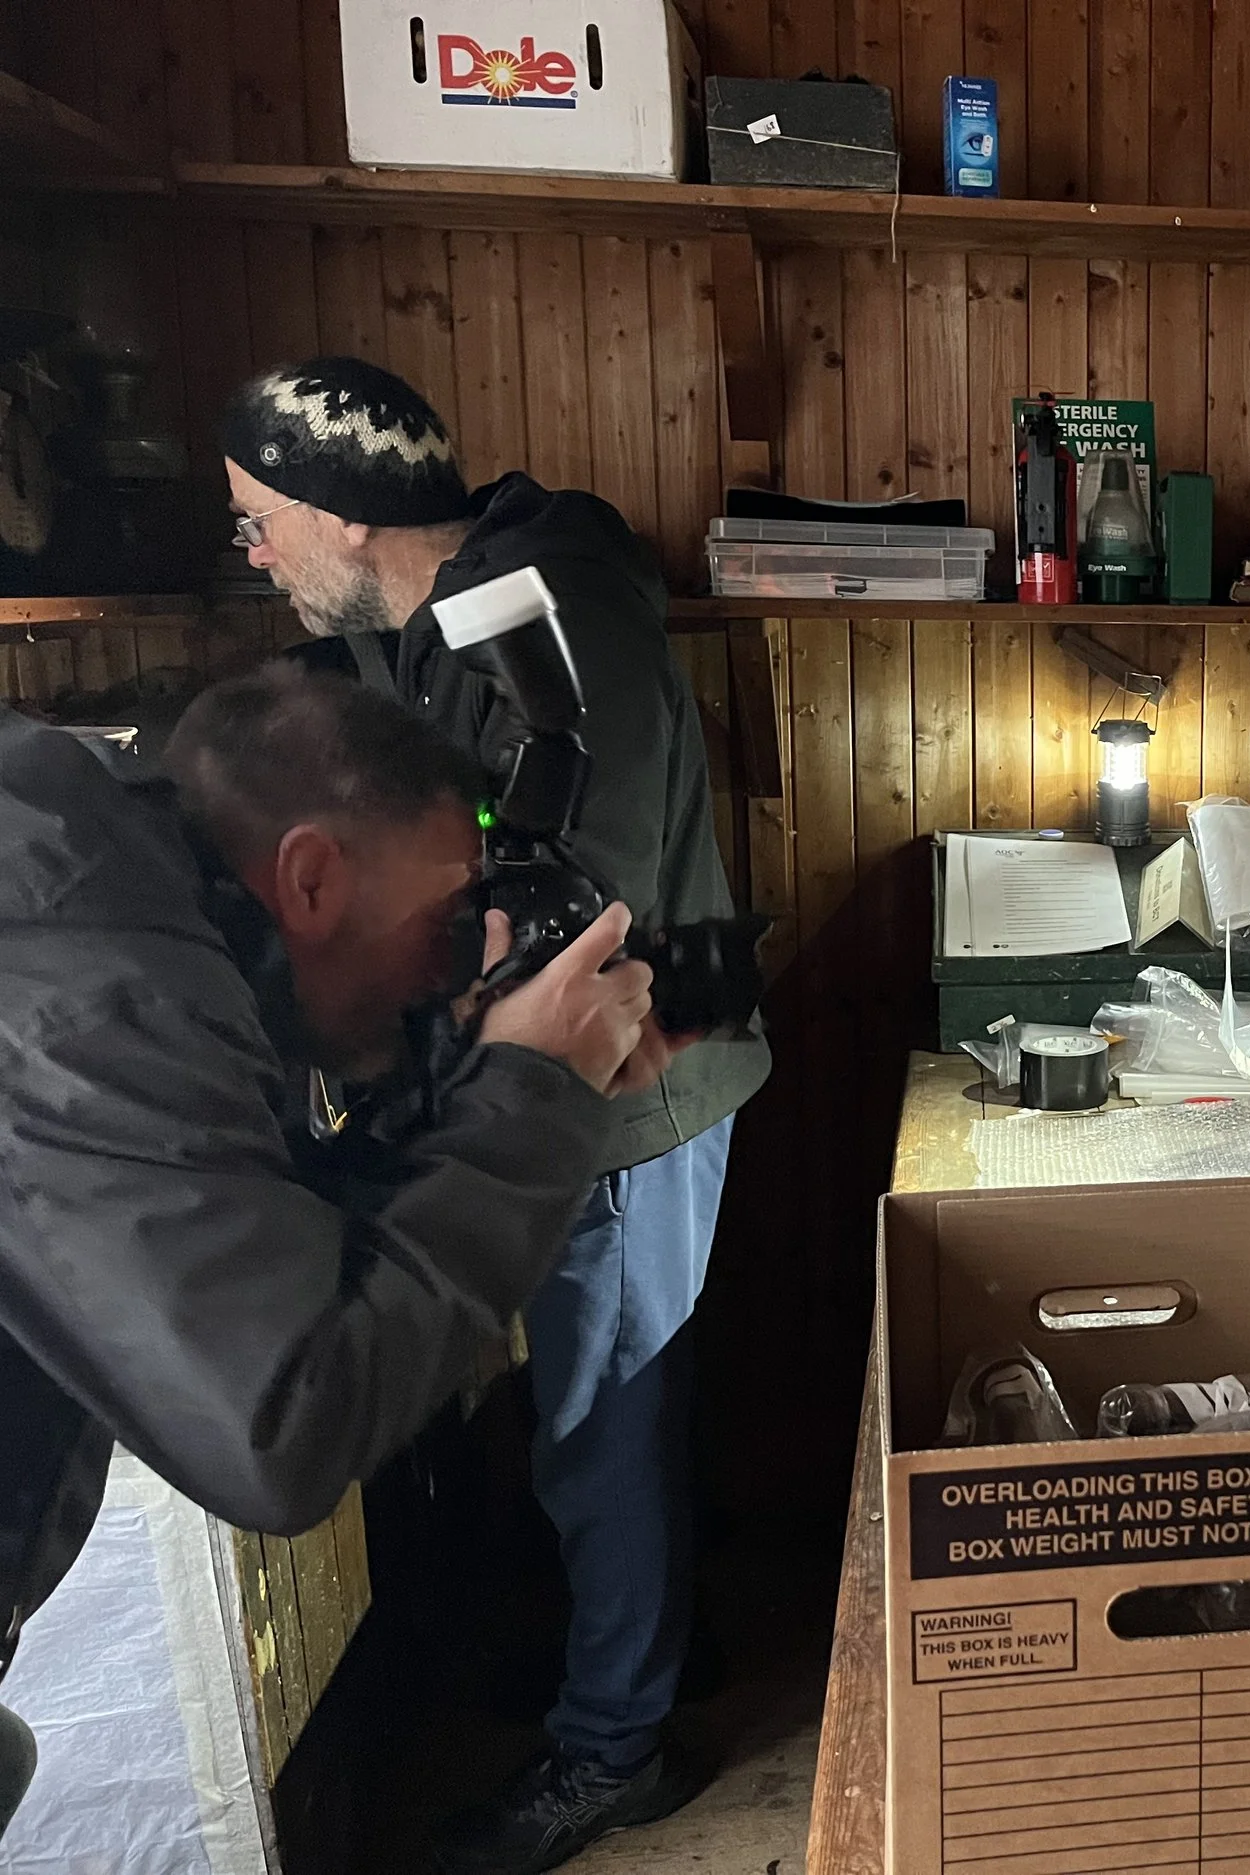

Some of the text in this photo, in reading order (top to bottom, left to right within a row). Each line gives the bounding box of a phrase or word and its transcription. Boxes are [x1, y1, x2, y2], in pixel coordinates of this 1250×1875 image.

[438, 35, 576, 98] Dole
[1053, 405, 1118, 420] STERILE
[1088, 564, 1127, 573] Eye Wash
[942, 1473, 1135, 1506] OVERLOADING
[1140, 1469, 1198, 1493] THIS
[1006, 1503, 1109, 1530] HEALTH
[1118, 1499, 1172, 1521] AND
[949, 1538, 1004, 1562] BOX
[1011, 1530, 1115, 1557] WEIGHT
[1122, 1525, 1196, 1549] MUST
[921, 1611, 1011, 1632] WARNING!
[920, 1632, 1069, 1656] THIS BOX IS HEAVY
[947, 1655, 995, 1671] WHEN
